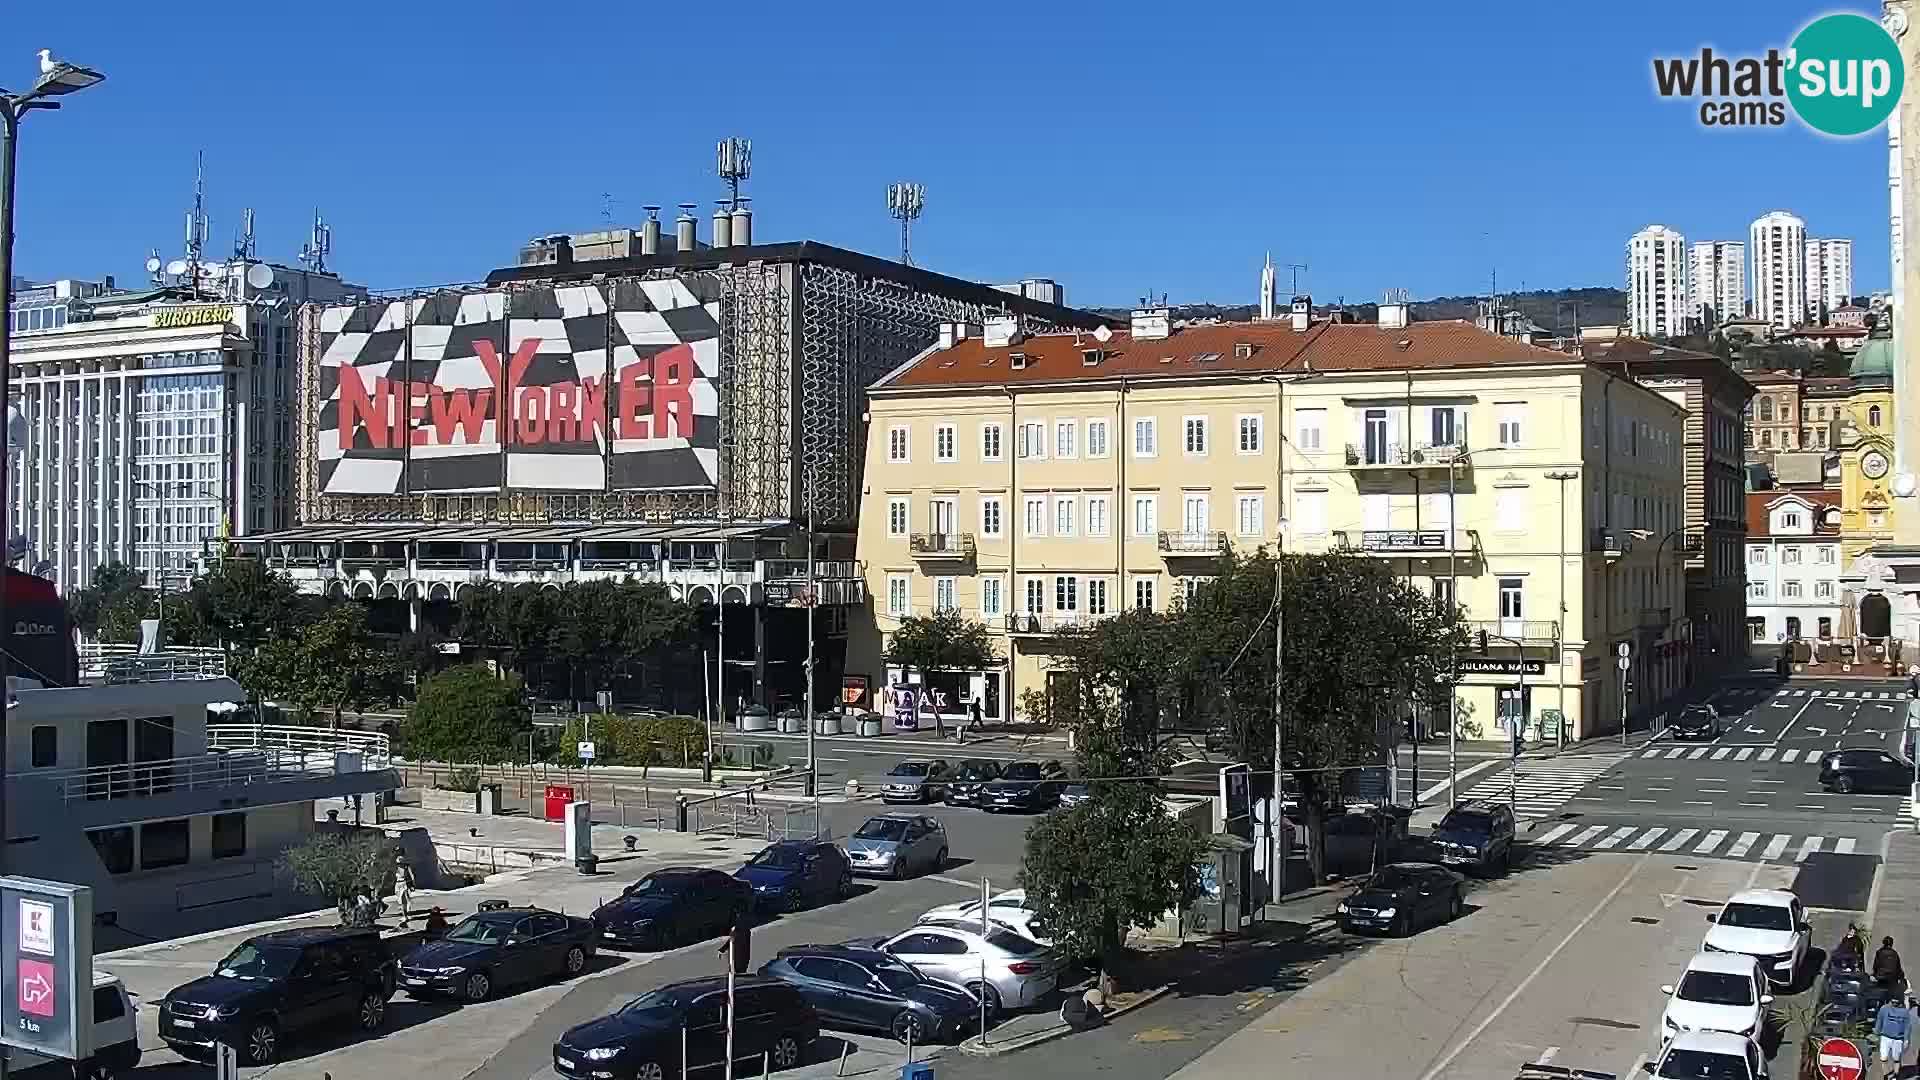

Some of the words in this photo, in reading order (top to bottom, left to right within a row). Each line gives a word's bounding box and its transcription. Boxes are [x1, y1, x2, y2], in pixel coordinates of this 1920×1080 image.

[339, 360, 494, 449] NEW
[472, 337, 695, 446] YORKER
[1458, 662, 1505, 671] JULIANA
[1508, 663, 1540, 672] NAILS
